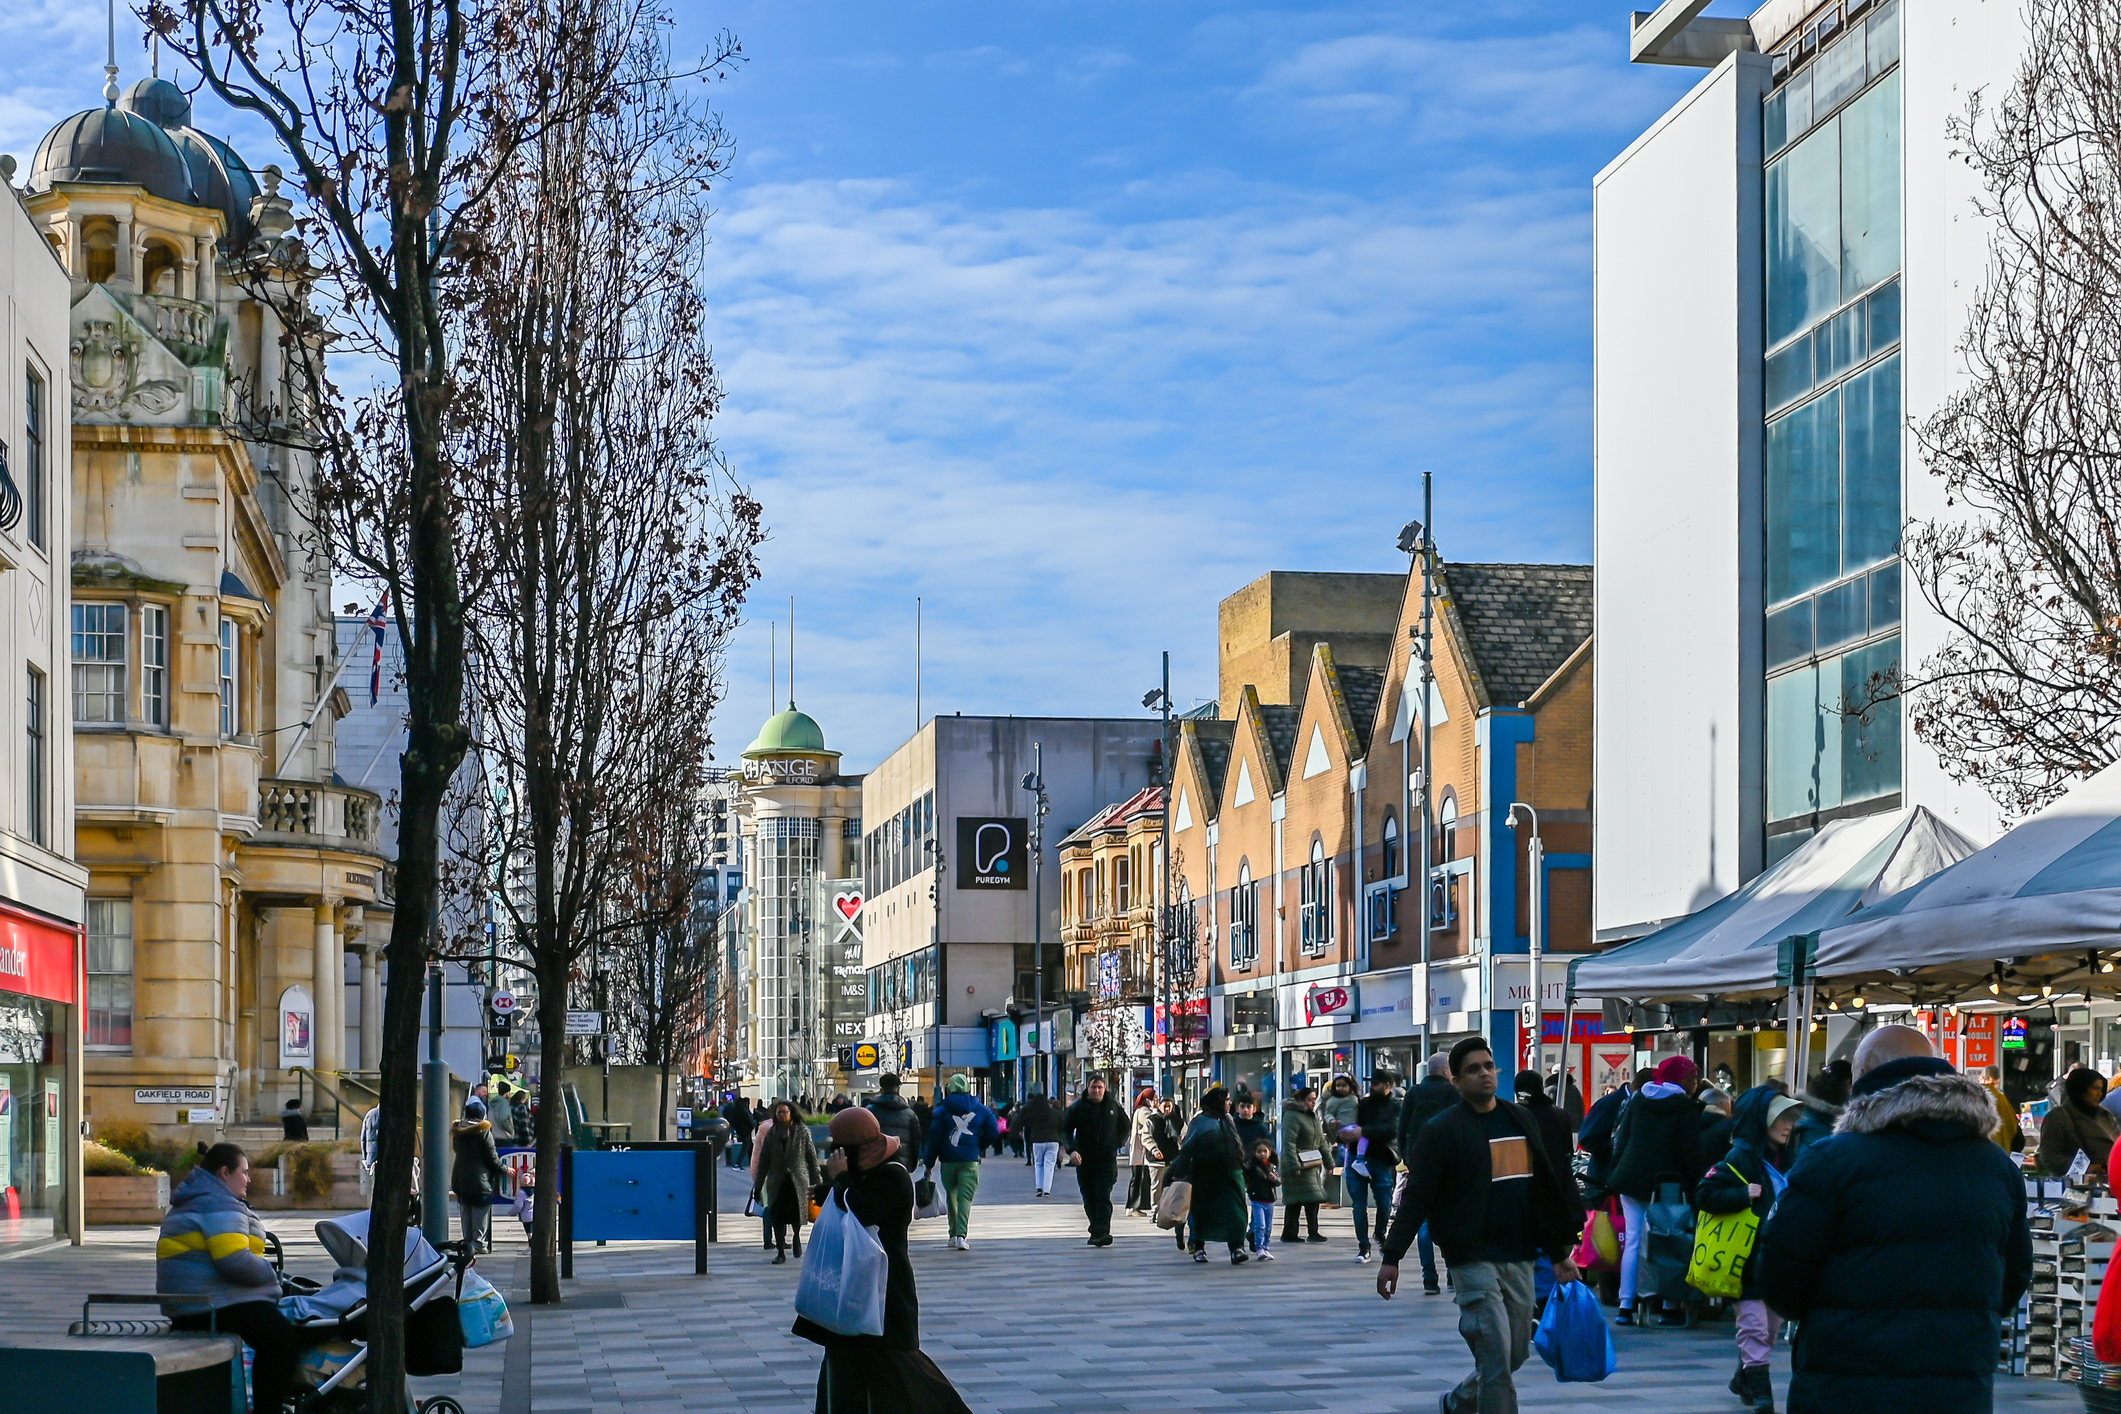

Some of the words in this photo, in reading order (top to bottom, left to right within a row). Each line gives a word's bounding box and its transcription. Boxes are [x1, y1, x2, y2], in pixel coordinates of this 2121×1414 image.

[786, 776, 813, 785] ILFORD
[975, 876, 1011, 884] PUREGYM
[843, 984, 865, 996] M&S
[1508, 982, 1567, 999] MIHT
[1969, 1017, 1988, 1028] A.F
[835, 1022, 866, 1035] NEX
[1975, 1043, 1982, 1051] &
[1969, 1053, 1988, 1062] VAPE
[137, 1090, 182, 1099] OAKFIELD
[184, 1090, 210, 1099] ROAD
